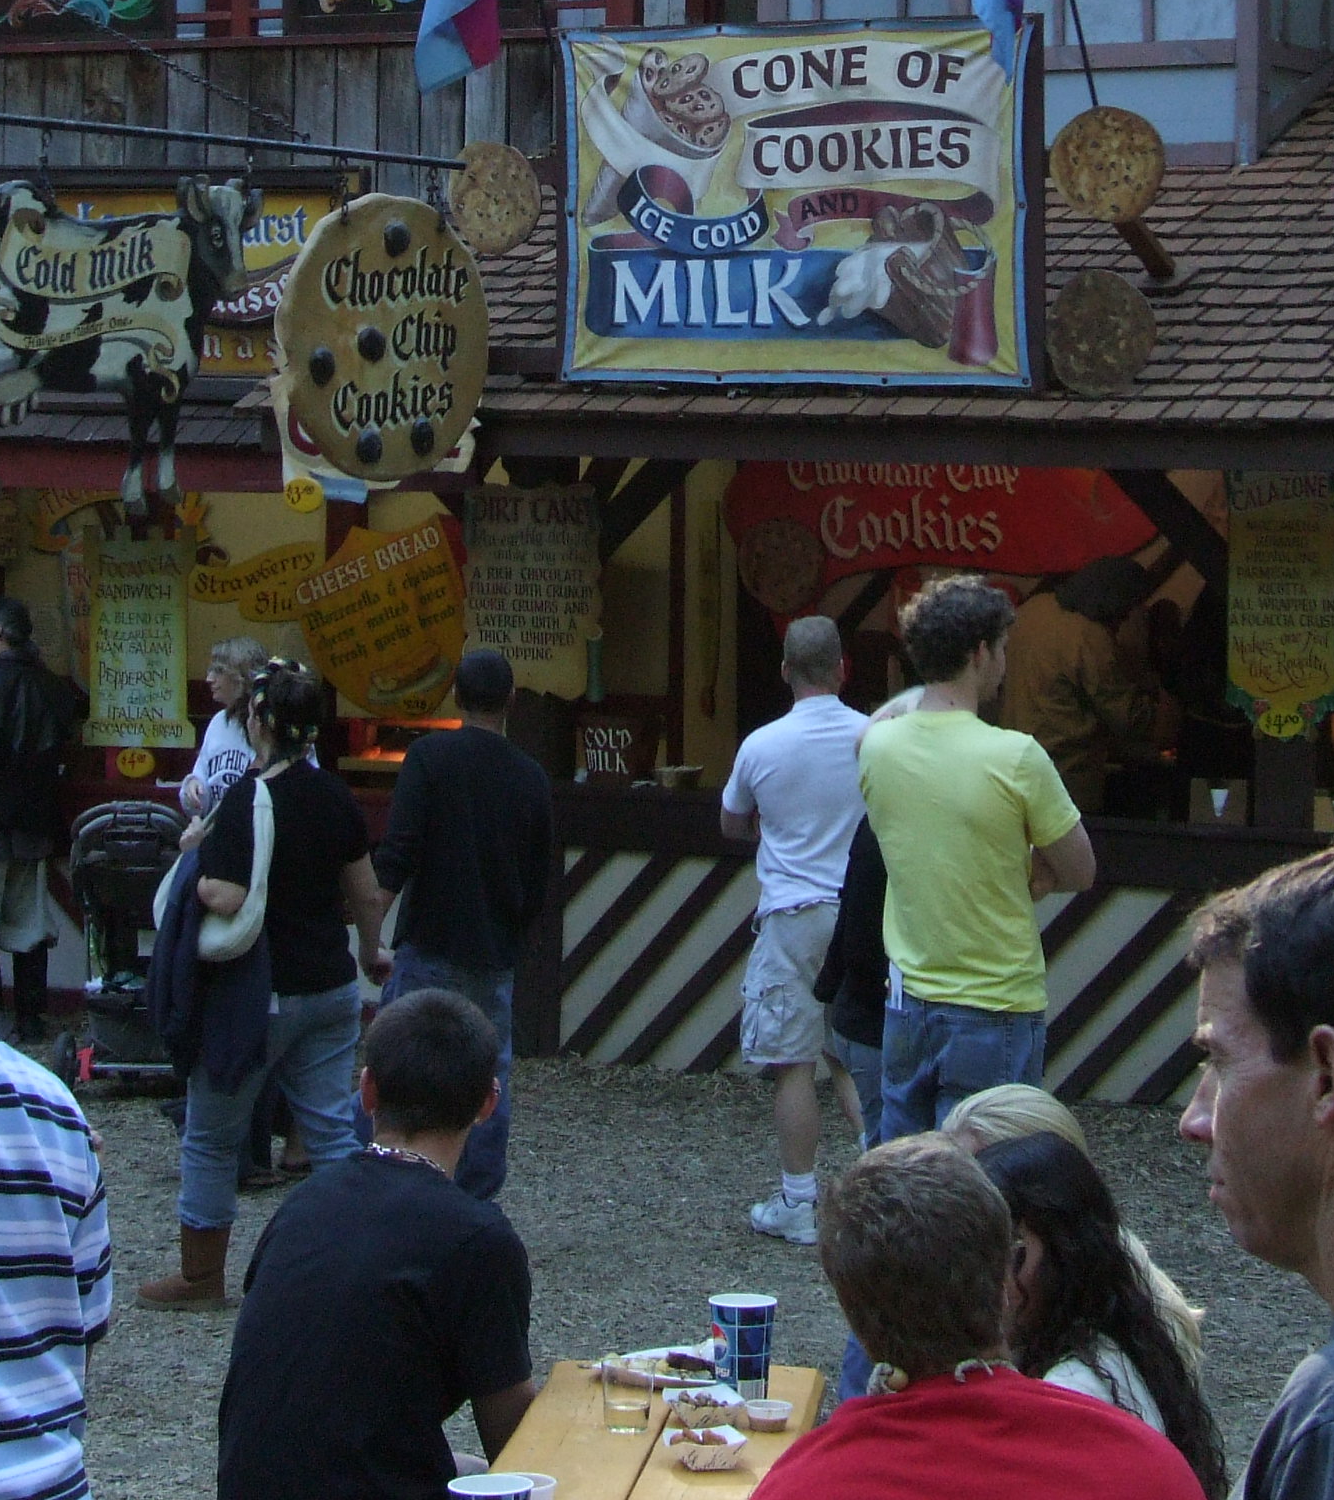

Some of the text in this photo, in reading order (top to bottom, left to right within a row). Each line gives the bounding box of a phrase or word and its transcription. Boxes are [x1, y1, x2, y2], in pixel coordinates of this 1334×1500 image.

[732, 45, 965, 99] CONE OF
[752, 126, 973, 176] COOKIES
[629, 196, 763, 251] ICE COLD
[800, 187, 861, 221] AND
[15, 244, 78, 294] Cold
[322, 246, 469, 311] Chocolate
[611, 257, 812, 330] MILK
[391, 309, 458, 375] Chip
[331, 370, 455, 437] Cookies
[819, 493, 1006, 559] Cookies
[193, 550, 316, 596] Strawberry
[294, 555, 373, 606] CHEESE
[373, 525, 441, 571] BREAD
[95, 583, 173, 600] SANDWICH
[114, 611, 152, 625] BLEND
[94, 641, 124, 655] HAM
[97, 660, 170, 691] PEPPERONI
[106, 703, 165, 722] ITALIAN
[583, 726, 633, 751] COLD
[585, 747, 630, 776] MILK
